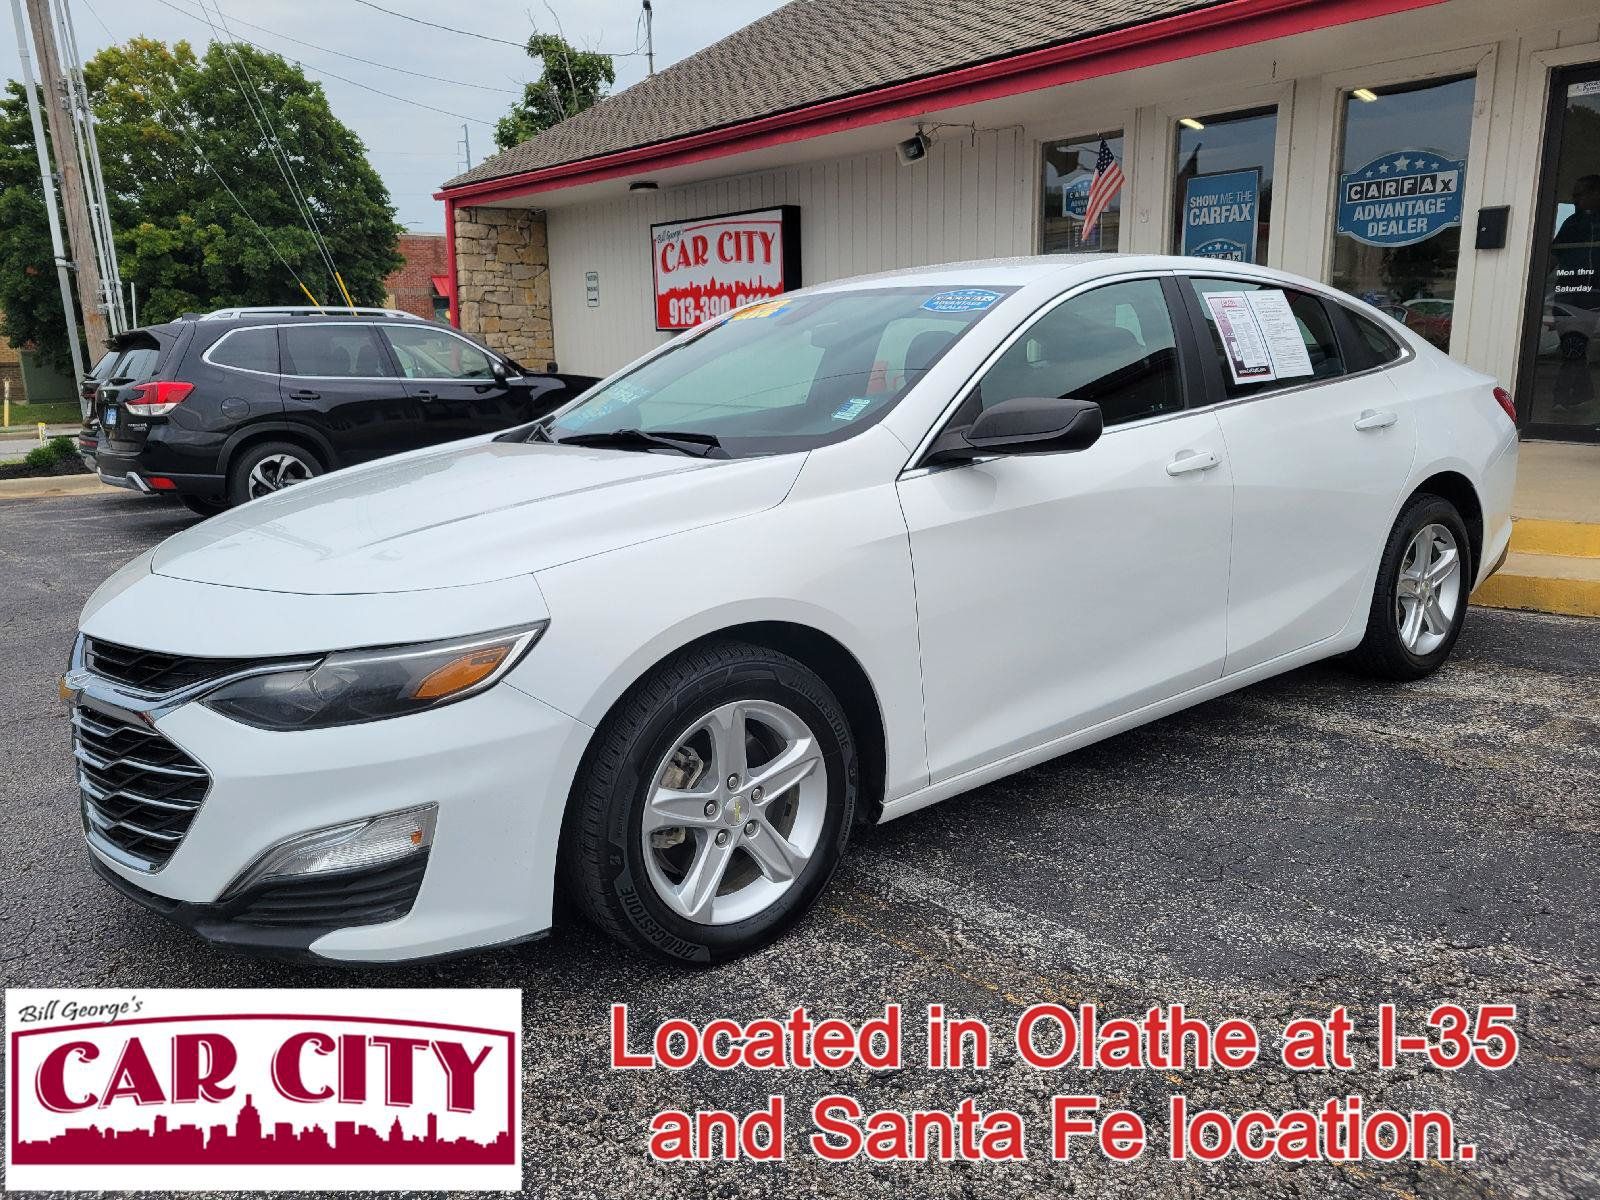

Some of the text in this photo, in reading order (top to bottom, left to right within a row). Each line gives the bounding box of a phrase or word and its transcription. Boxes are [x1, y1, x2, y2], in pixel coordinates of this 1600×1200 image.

[1189, 189, 1253, 208] SHOW ME THE
[1349, 176, 1453, 200] CARFAX
[1188, 202, 1252, 226] CARFAX
[1366, 217, 1428, 238] DEALER
[660, 230, 776, 274] CAR CITY
[1556, 267, 1595, 277] Mon thru
[1554, 284, 1593, 293] Saturday
